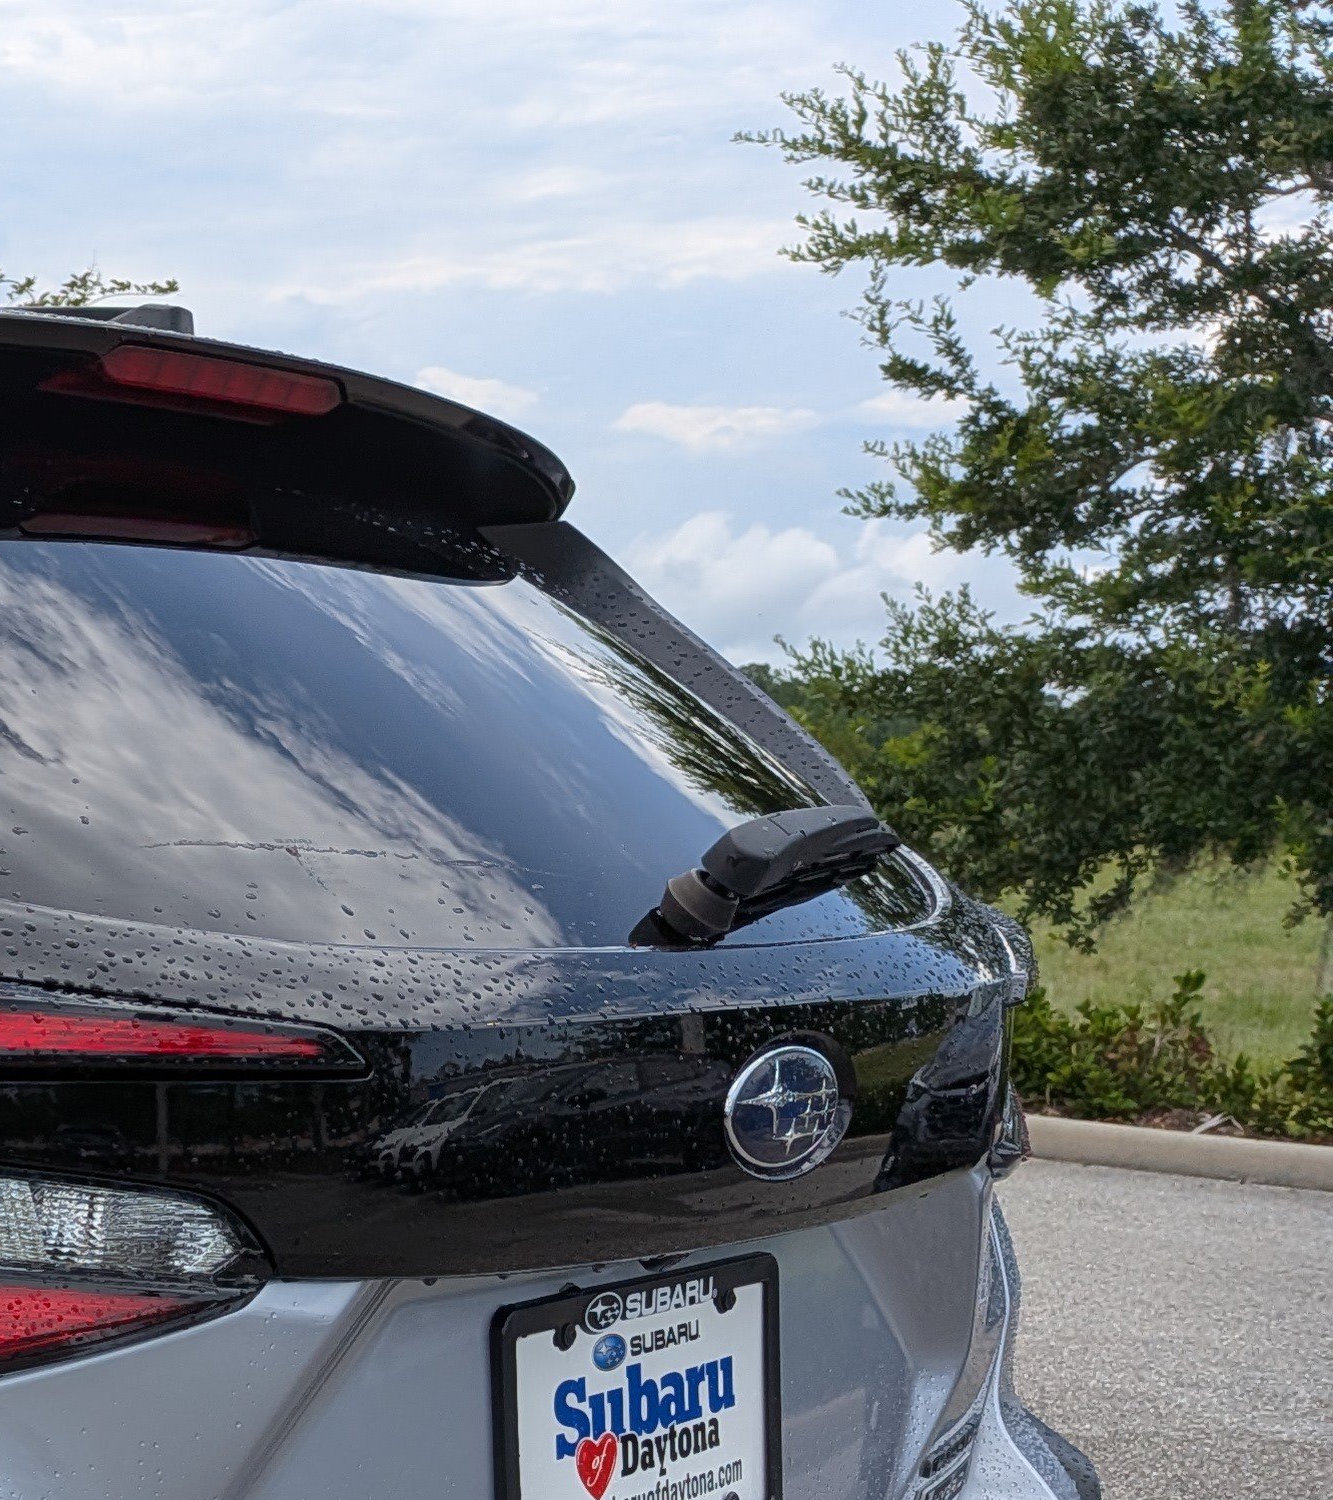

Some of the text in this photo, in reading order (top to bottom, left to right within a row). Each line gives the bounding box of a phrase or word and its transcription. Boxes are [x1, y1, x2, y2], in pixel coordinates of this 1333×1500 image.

[625, 1276, 718, 1319] SUBARU
[629, 1319, 700, 1357] SUBARU
[553, 1355, 735, 1460] Subaru
[586, 1417, 720, 1487] of Daytona
